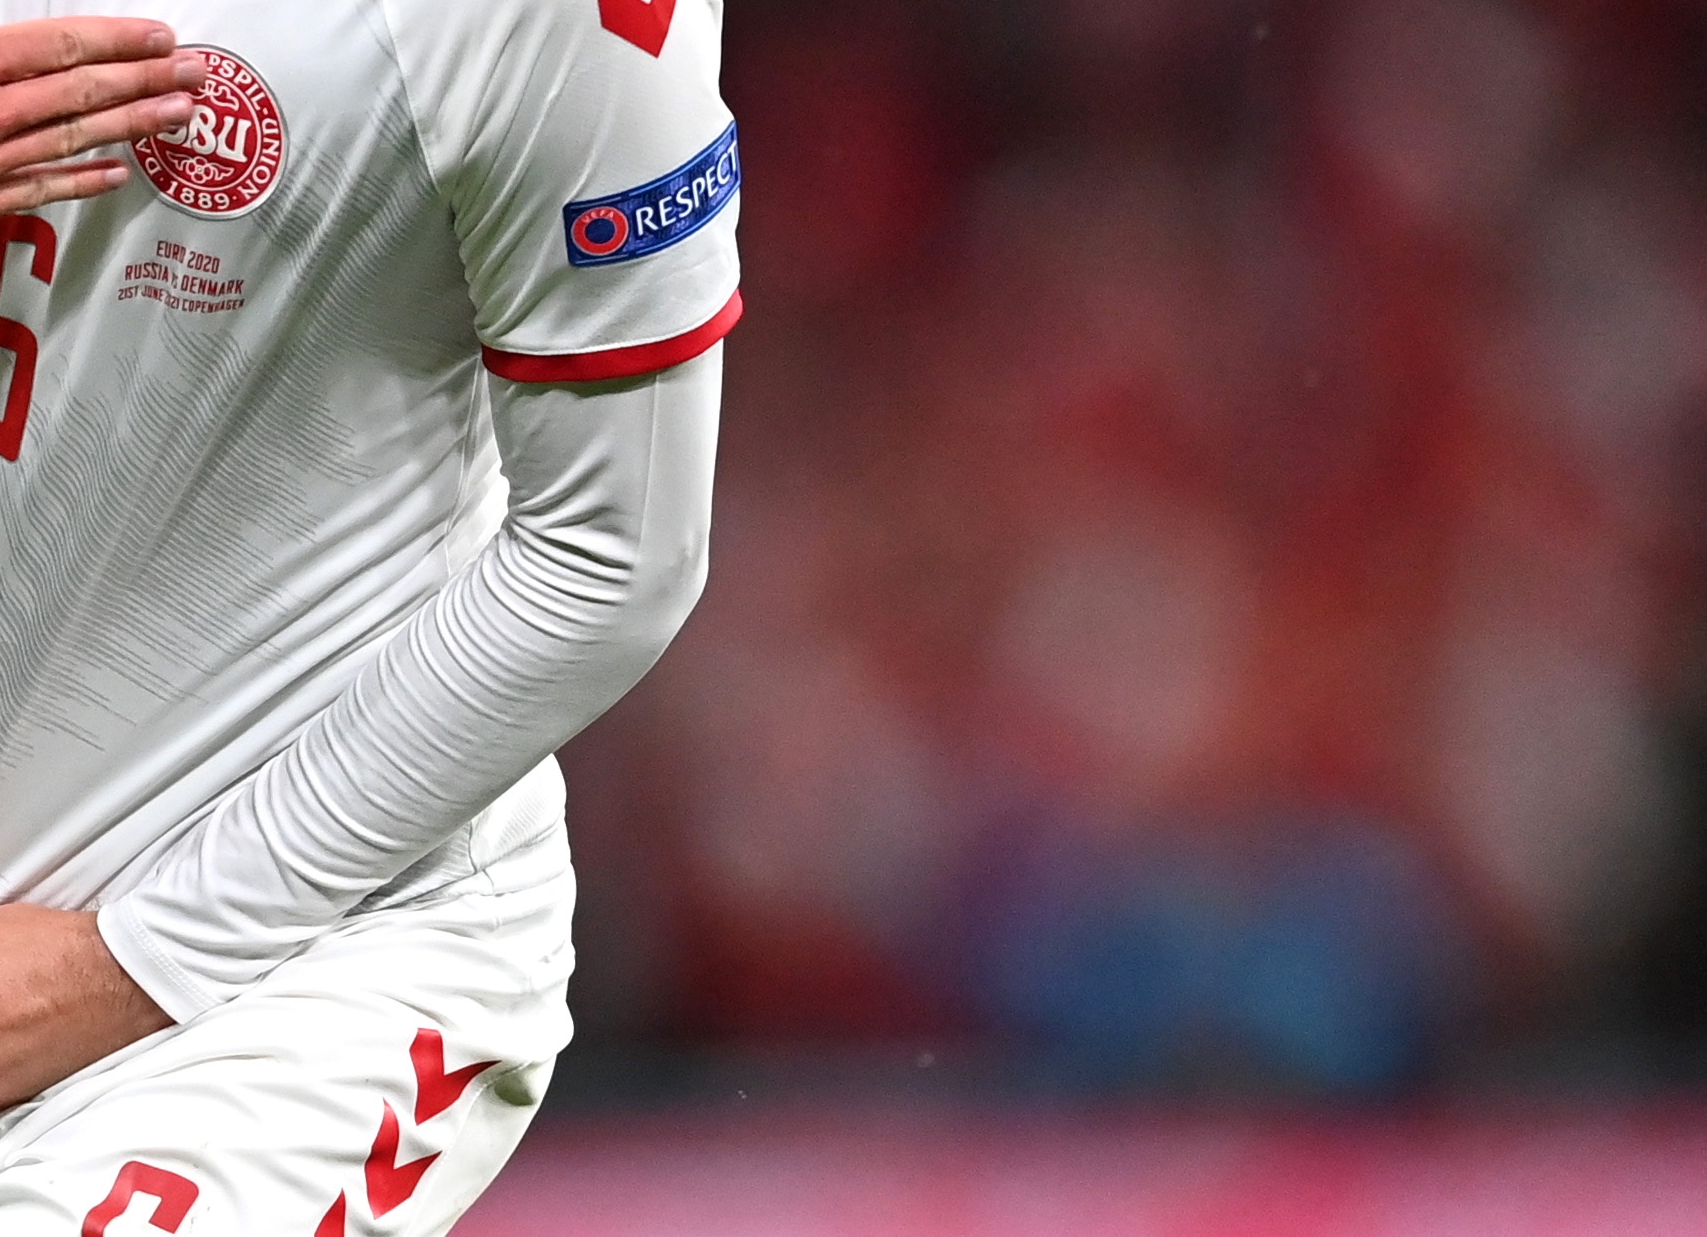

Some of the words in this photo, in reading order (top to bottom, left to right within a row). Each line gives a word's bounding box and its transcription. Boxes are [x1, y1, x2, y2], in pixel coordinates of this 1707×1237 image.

[198, 53, 280, 200] DSPIL-UNION
[166, 181, 230, 210] 1889
[635, 140, 738, 236] RESPECT
[581, 209, 614, 223] UEFA
[156, 240, 187, 264] EURO
[187, 251, 221, 275] 2020
[124, 262, 169, 282] RUSSIA
[180, 274, 245, 297] DENMARK
[117, 285, 139, 301] 21ST
[141, 285, 163, 302] JUNE
[181, 298, 245, 314] COPENHAGEN
